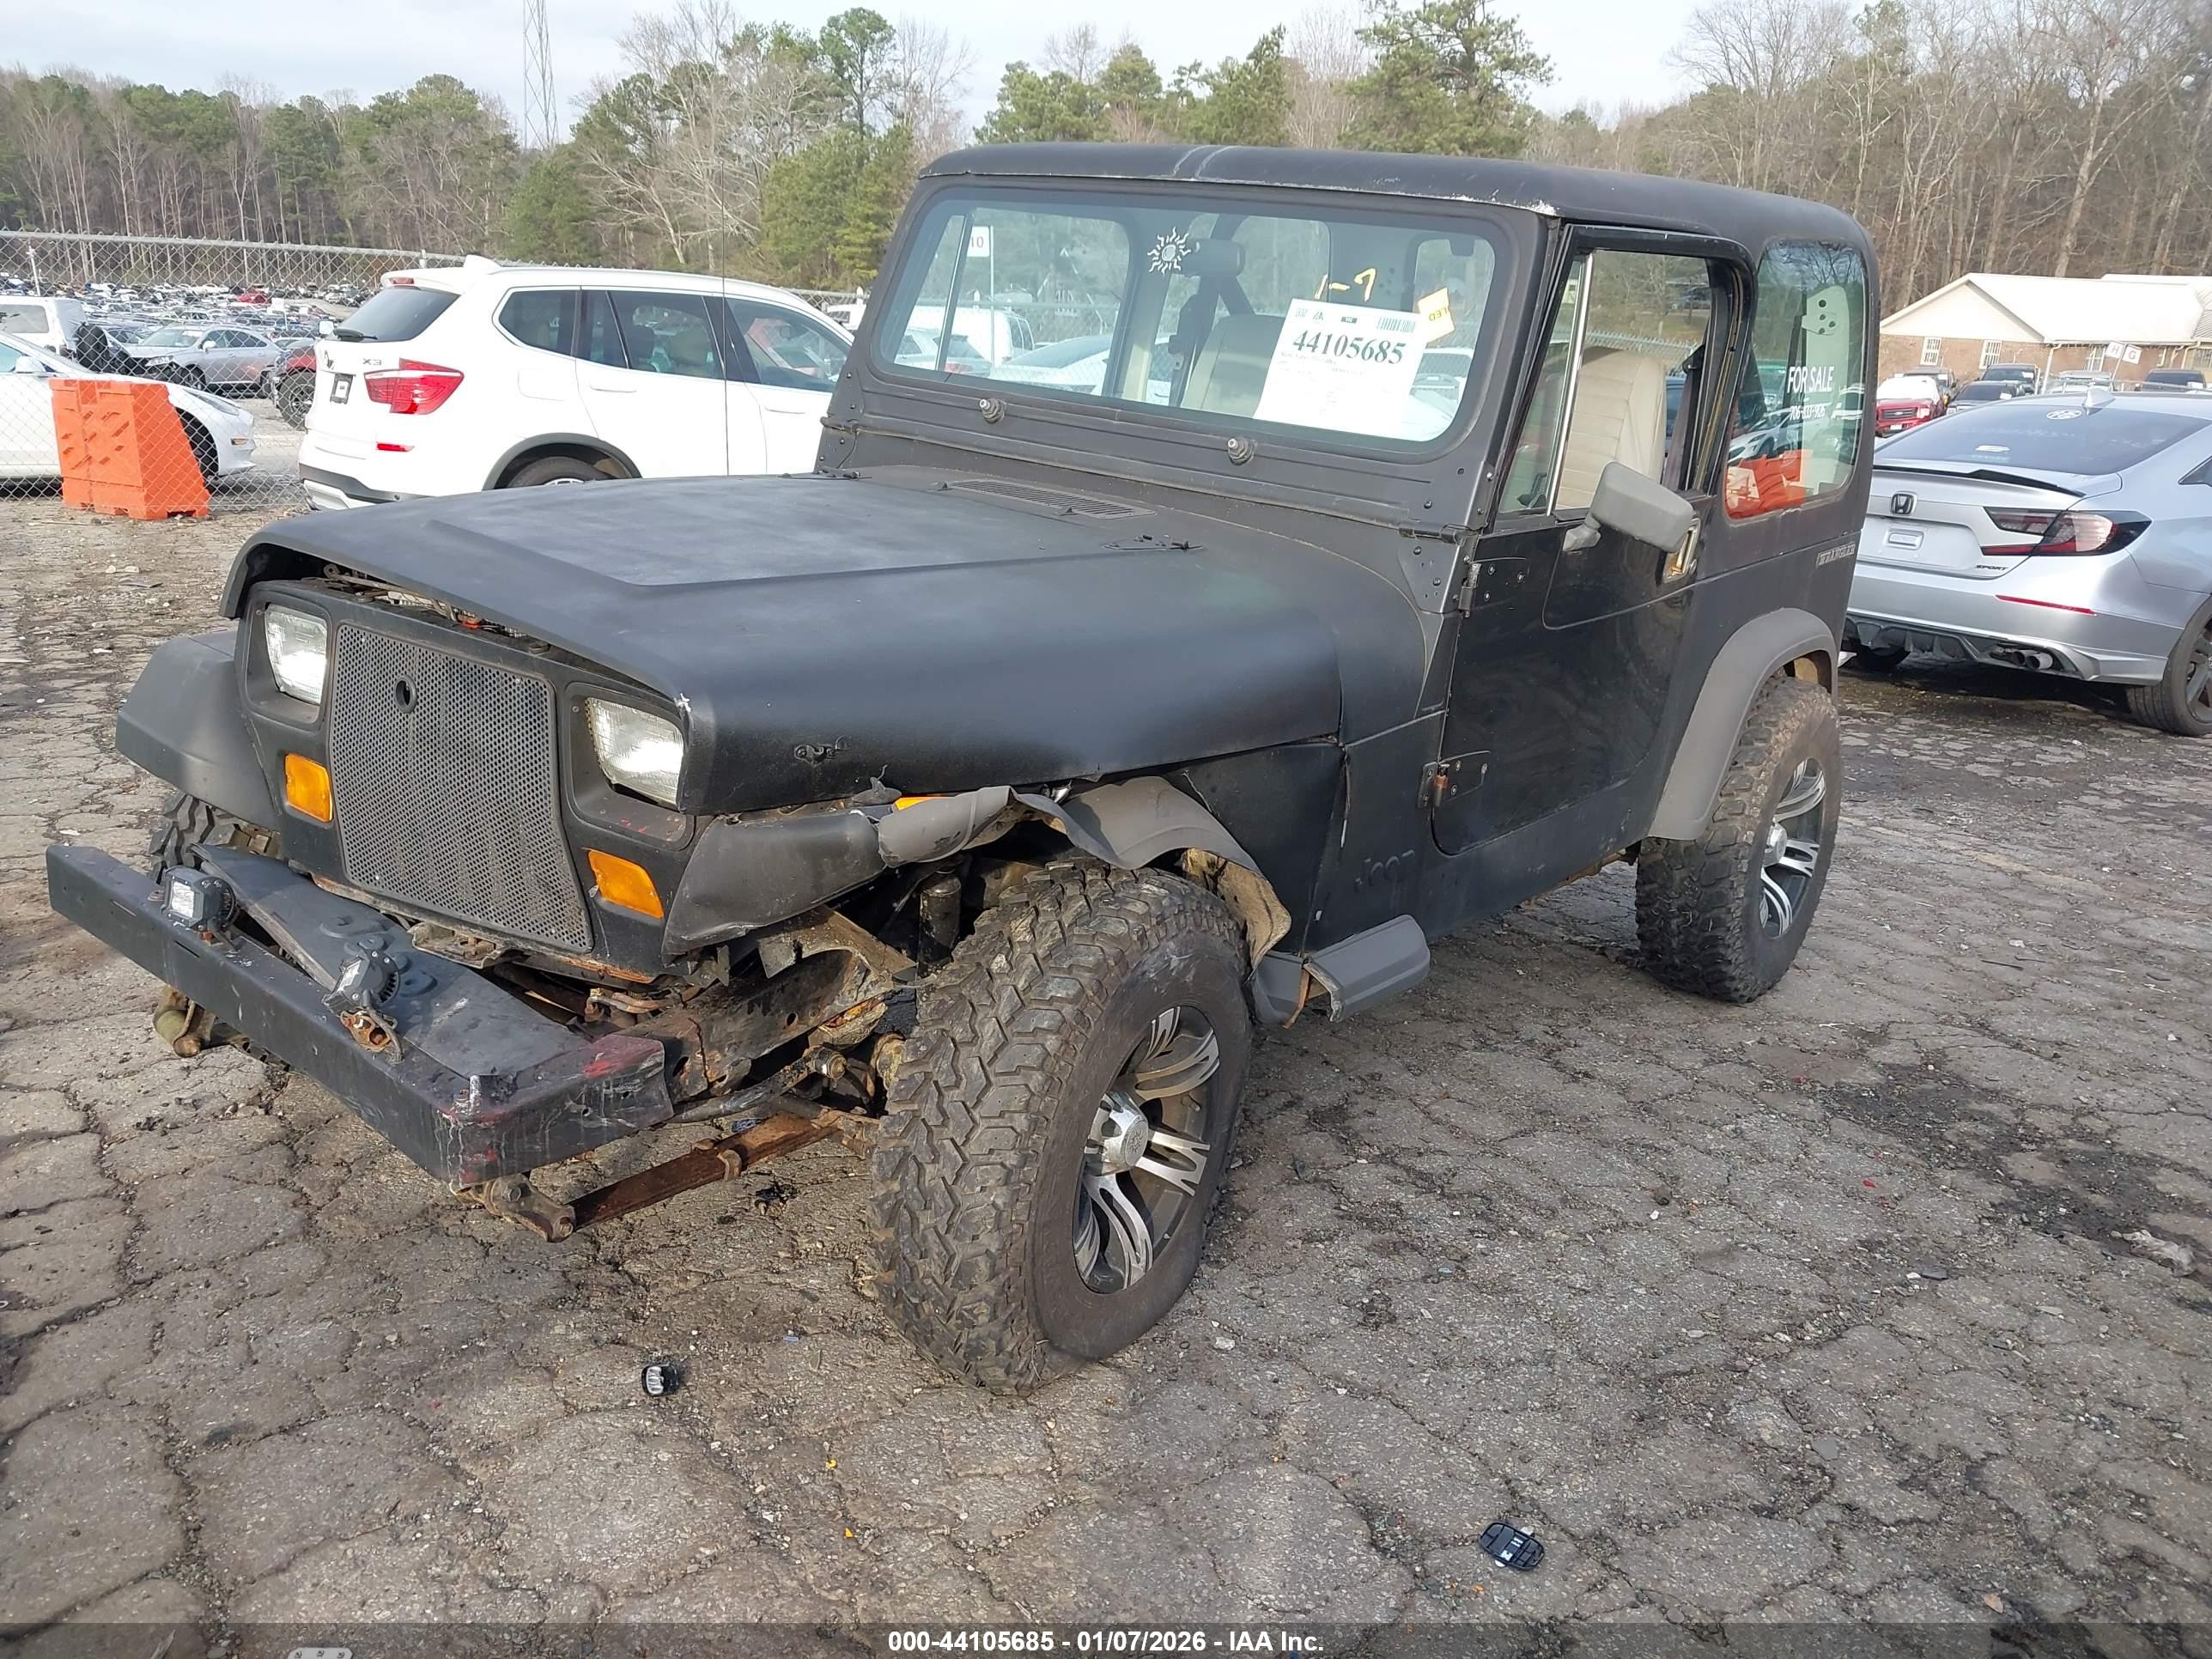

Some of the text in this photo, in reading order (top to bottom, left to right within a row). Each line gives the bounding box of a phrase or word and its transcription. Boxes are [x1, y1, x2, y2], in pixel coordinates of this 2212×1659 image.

[1292, 330, 1407, 364] 44105685
[2129, 350, 2137, 360] G
[1787, 366, 1835, 393] FOR SALE
